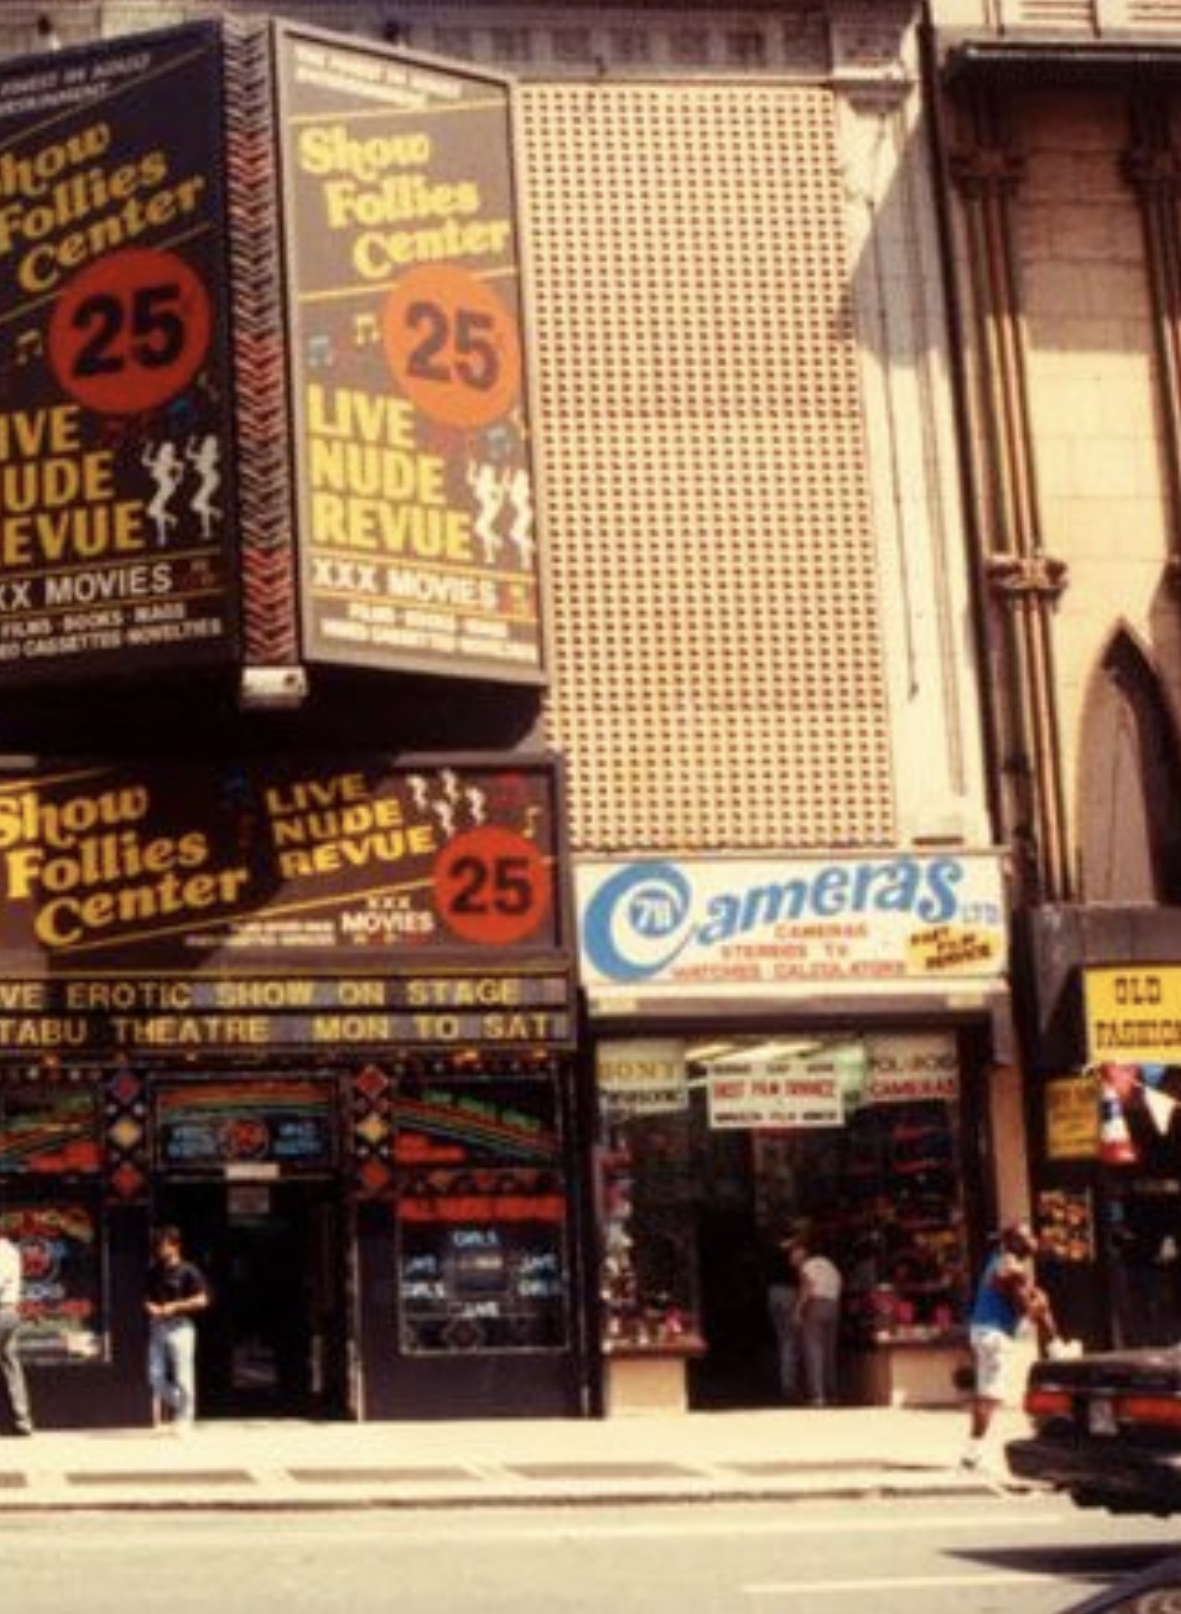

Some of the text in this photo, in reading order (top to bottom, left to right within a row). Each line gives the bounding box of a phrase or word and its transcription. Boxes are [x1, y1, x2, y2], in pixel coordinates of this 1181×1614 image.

[298, 125, 431, 181] Show
[325, 174, 480, 230] Follies
[19, 174, 205, 292] Center
[354, 218, 512, 279] Center
[72, 283, 185, 378] 25
[405, 301, 501, 392] 25
[307, 383, 416, 449] LIVE
[309, 439, 445, 504] NUDE
[311, 491, 473, 560] REVUE
[45, 563, 173, 605] MOVIES
[313, 557, 498, 608] XXX MOVIES
[268, 773, 365, 815] LIVE
[273, 798, 404, 846] NUDE
[6, 831, 209, 899] Follies
[280, 825, 437, 880] REVUE
[33, 868, 249, 947] Center
[447, 855, 535, 916] 25
[341, 911, 434, 934] MOVIES
[774, 922, 869, 939] CAMERAS
[65, 981, 192, 1009] EROTIC
[215, 980, 312, 1008] SHOW
[337, 980, 385, 1007] ON
[407, 978, 519, 1007] STAGE
[671, 960, 906, 981] WATCHES CALCULATORS
[1115, 975, 1161, 1006] OLD
[110, 1015, 269, 1044] THEATRE
[313, 1014, 389, 1043] MON
[413, 1013, 459, 1041] TO
[481, 1013, 549, 1041] SAT
